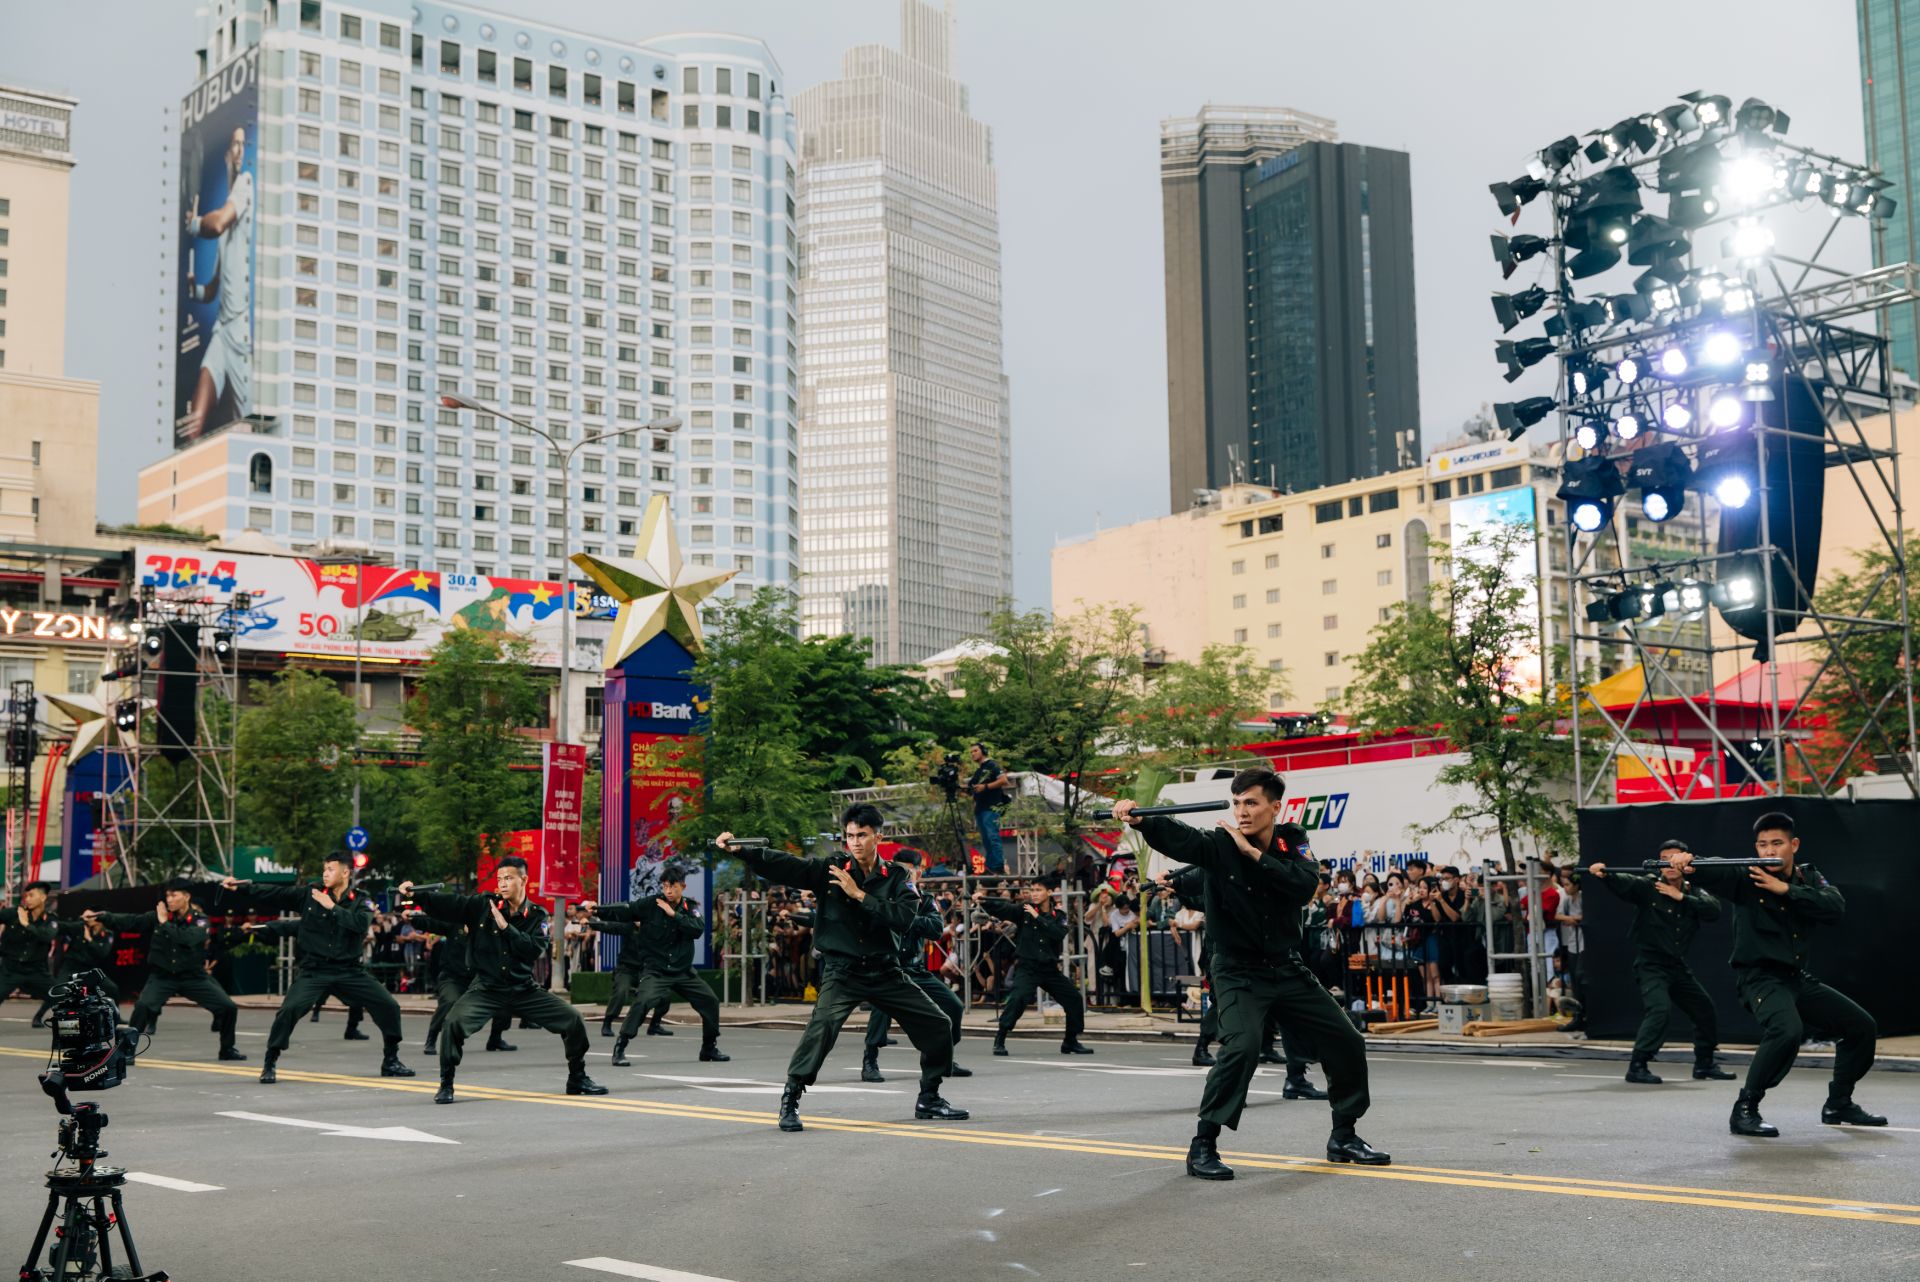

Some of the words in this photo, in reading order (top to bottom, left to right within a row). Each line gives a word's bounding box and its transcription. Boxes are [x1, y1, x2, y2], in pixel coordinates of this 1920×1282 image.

[181, 46, 258, 133] HUBLOT
[4, 112, 61, 137] HOTEL
[1636, 468, 1653, 476] SVT
[142, 555, 238, 592] 30-4
[448, 574, 477, 586] 30.4
[0, 609, 21, 635] Y
[298, 612, 337, 637] 50
[628, 702, 692, 719] HDBank
[1284, 797, 1348, 830] HTV
[83, 1065, 108, 1083] RONIN
